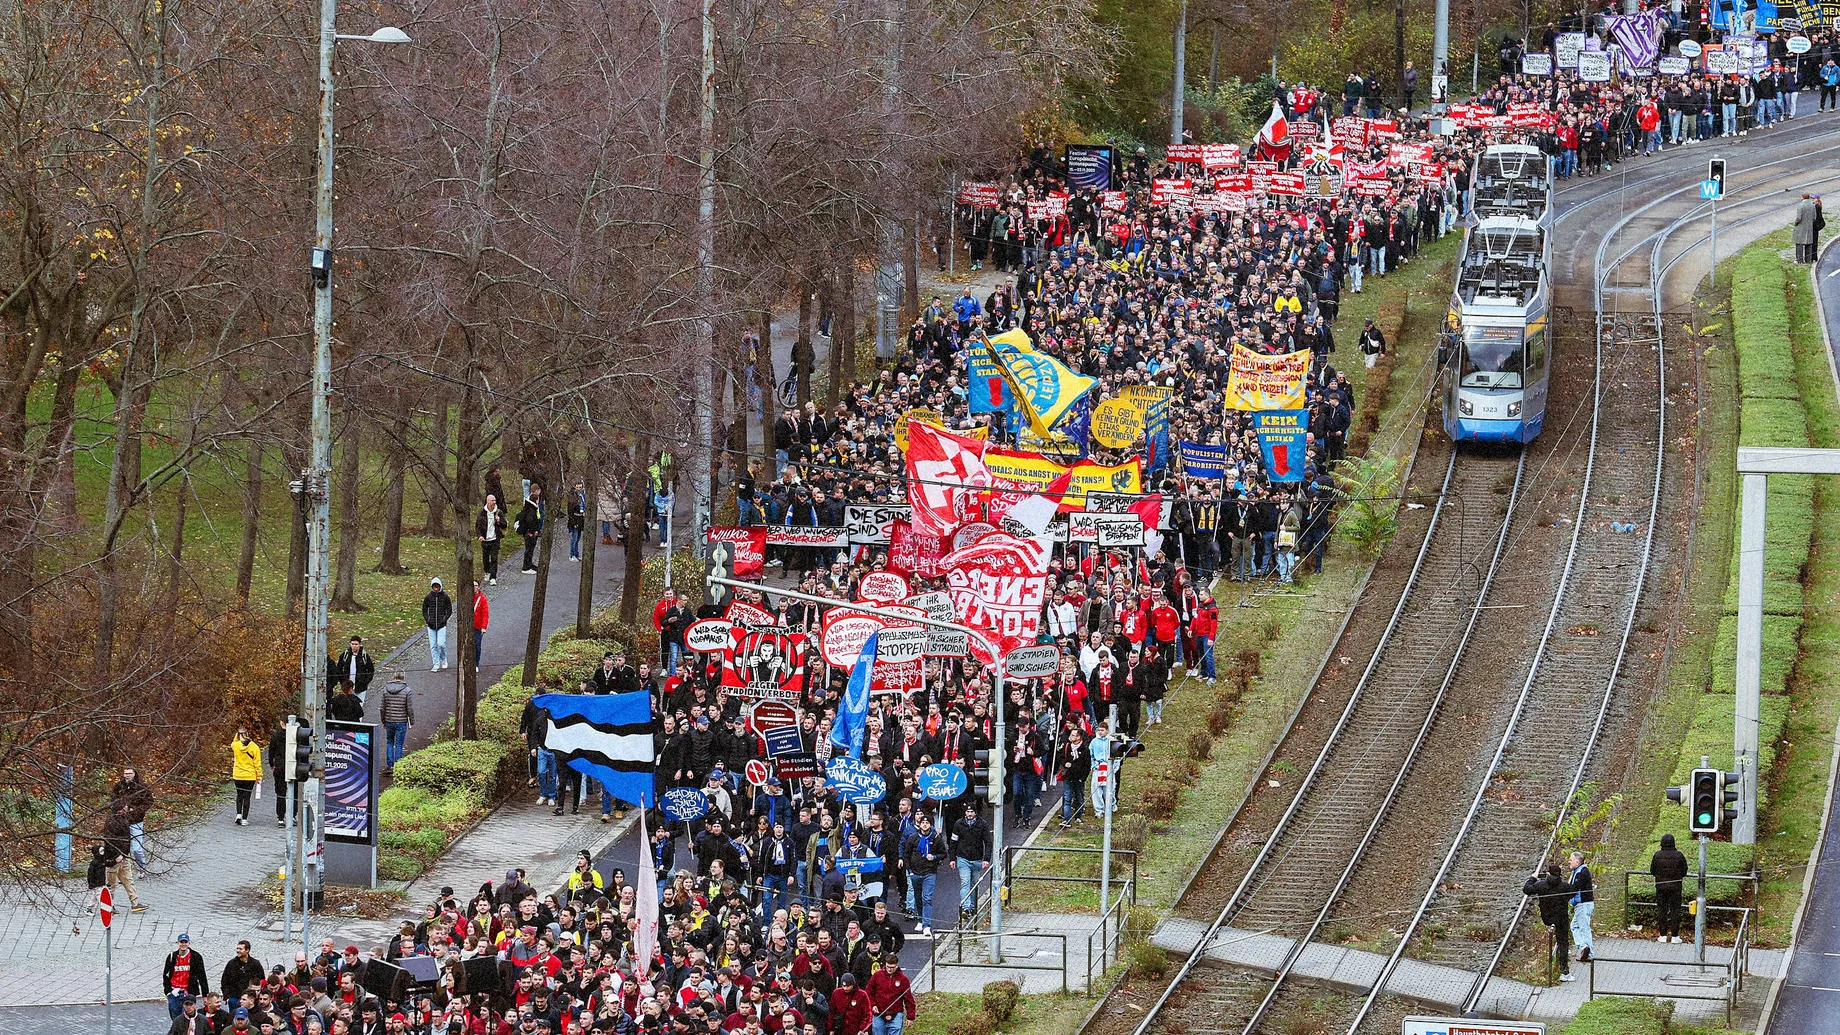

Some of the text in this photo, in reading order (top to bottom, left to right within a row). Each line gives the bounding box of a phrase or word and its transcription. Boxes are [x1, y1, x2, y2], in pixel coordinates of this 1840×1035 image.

[1703, 183, 1717, 196] W
[1103, 406, 1135, 421] ES GIBT
[1096, 414, 1139, 427] KEINEN GRUND
[1261, 416, 1298, 426] KEIN
[1098, 423, 1134, 434] ETWAS ZU
[1182, 448, 1224, 458] POPULISTEN
[1013, 469, 1027, 477] AUS
[1028, 470, 1050, 479] ANGST
[711, 528, 749, 543] WILLKÜR
[733, 549, 763, 562] ANKULTUR
[748, 681, 777, 690] GEGEN
[722, 686, 802, 699] STADIONVERBOTE
[926, 767, 949, 778] PYRO
